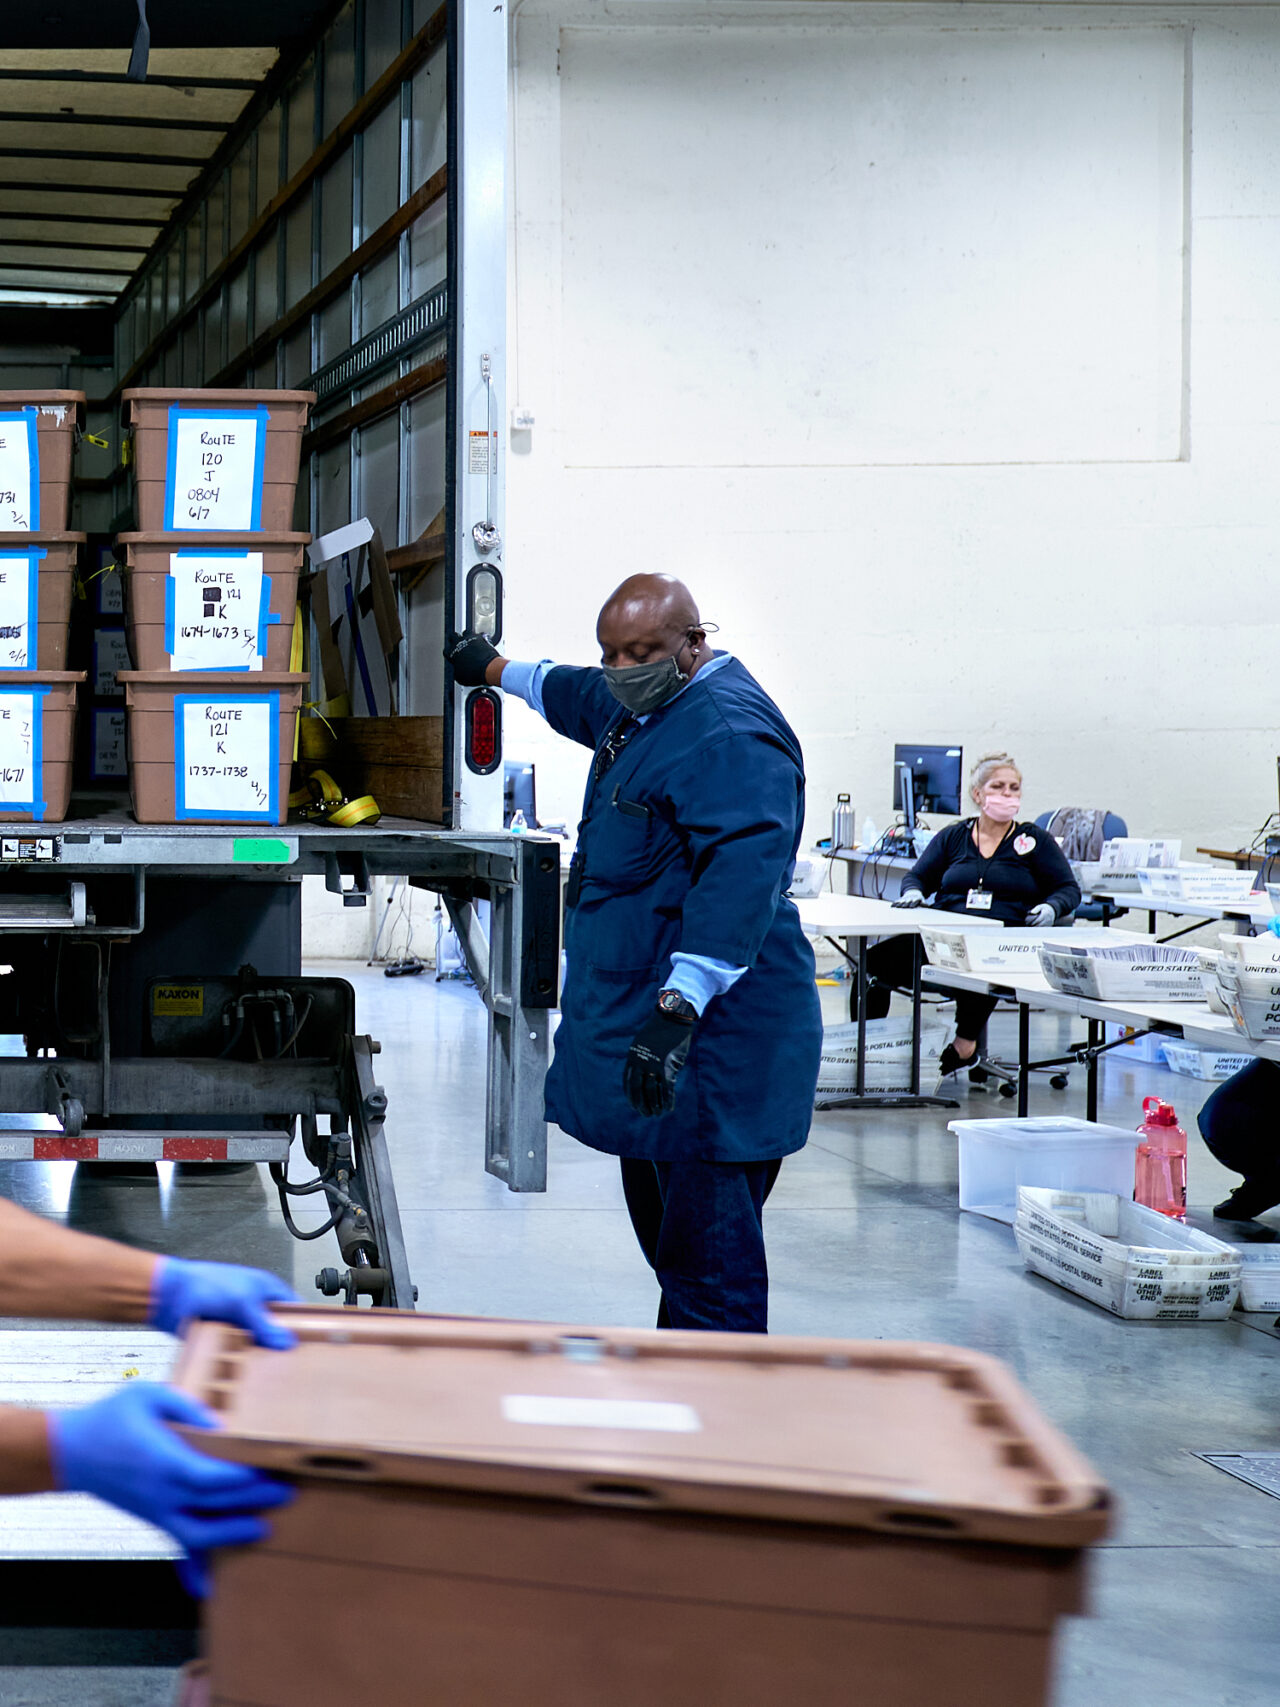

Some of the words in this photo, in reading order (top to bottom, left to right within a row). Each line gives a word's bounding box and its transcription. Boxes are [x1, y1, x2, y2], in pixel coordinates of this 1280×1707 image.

[200, 431, 236, 446] ROUTE
[201, 452, 223, 466] 120
[204, 470, 215, 482] J
[187, 487, 220, 503] 0804
[188, 506, 210, 520] 6/7
[194, 569, 236, 584] ROUTE
[227, 588, 241, 600] 121
[219, 604, 227, 620] K
[181, 625, 239, 640] 1674-1673
[205, 706, 242, 721] ROUTE
[210, 723, 228, 737] 121
[217, 741, 226, 754] K
[189, 766, 248, 778] 1737-1738
[158, 989, 199, 1000] MAXON
[1140, 1268, 1164, 1276] LABEL
